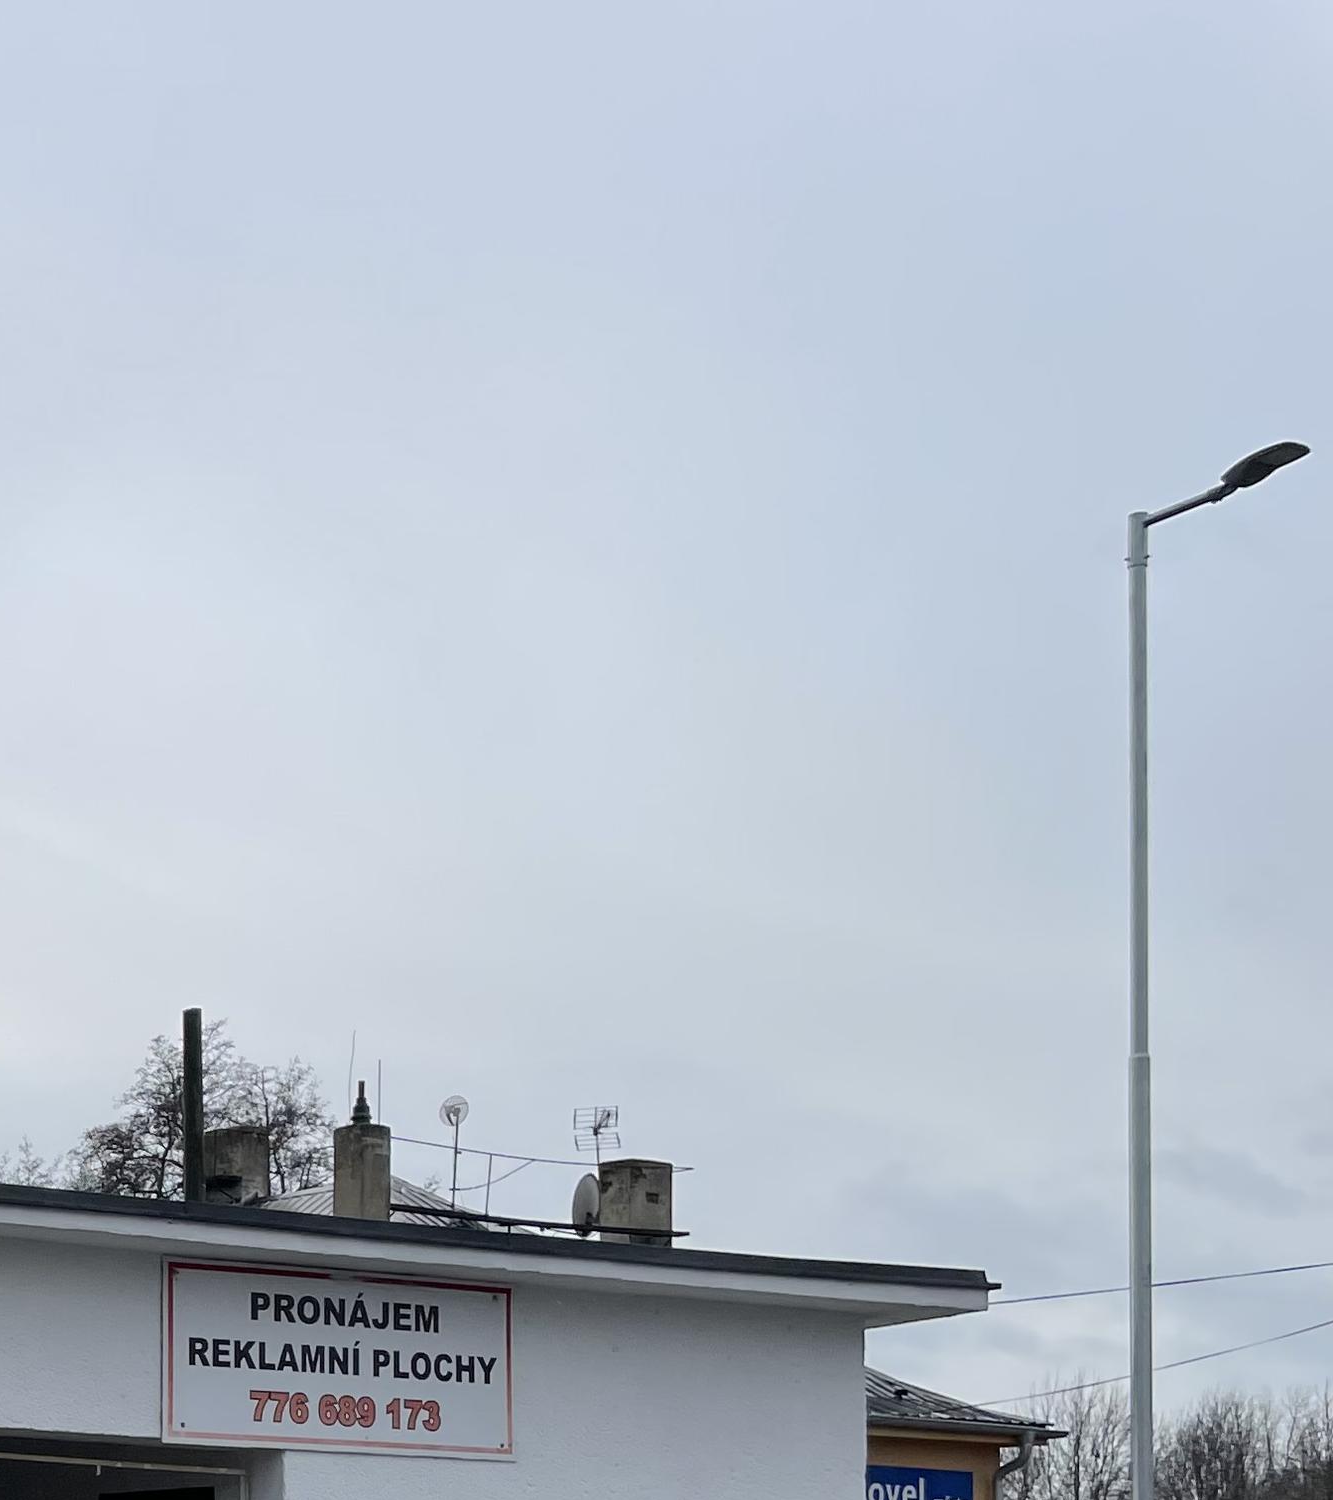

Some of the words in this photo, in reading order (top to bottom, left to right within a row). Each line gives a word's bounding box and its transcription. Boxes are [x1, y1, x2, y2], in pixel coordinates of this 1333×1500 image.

[250, 1291, 440, 1334] PRONÁJEM
[188, 1337, 361, 1376] REKLAMNÍ
[373, 1350, 497, 1385] PLOCHY
[250, 1390, 310, 1424] 776
[318, 1394, 376, 1428] 689
[386, 1398, 442, 1432] 173
